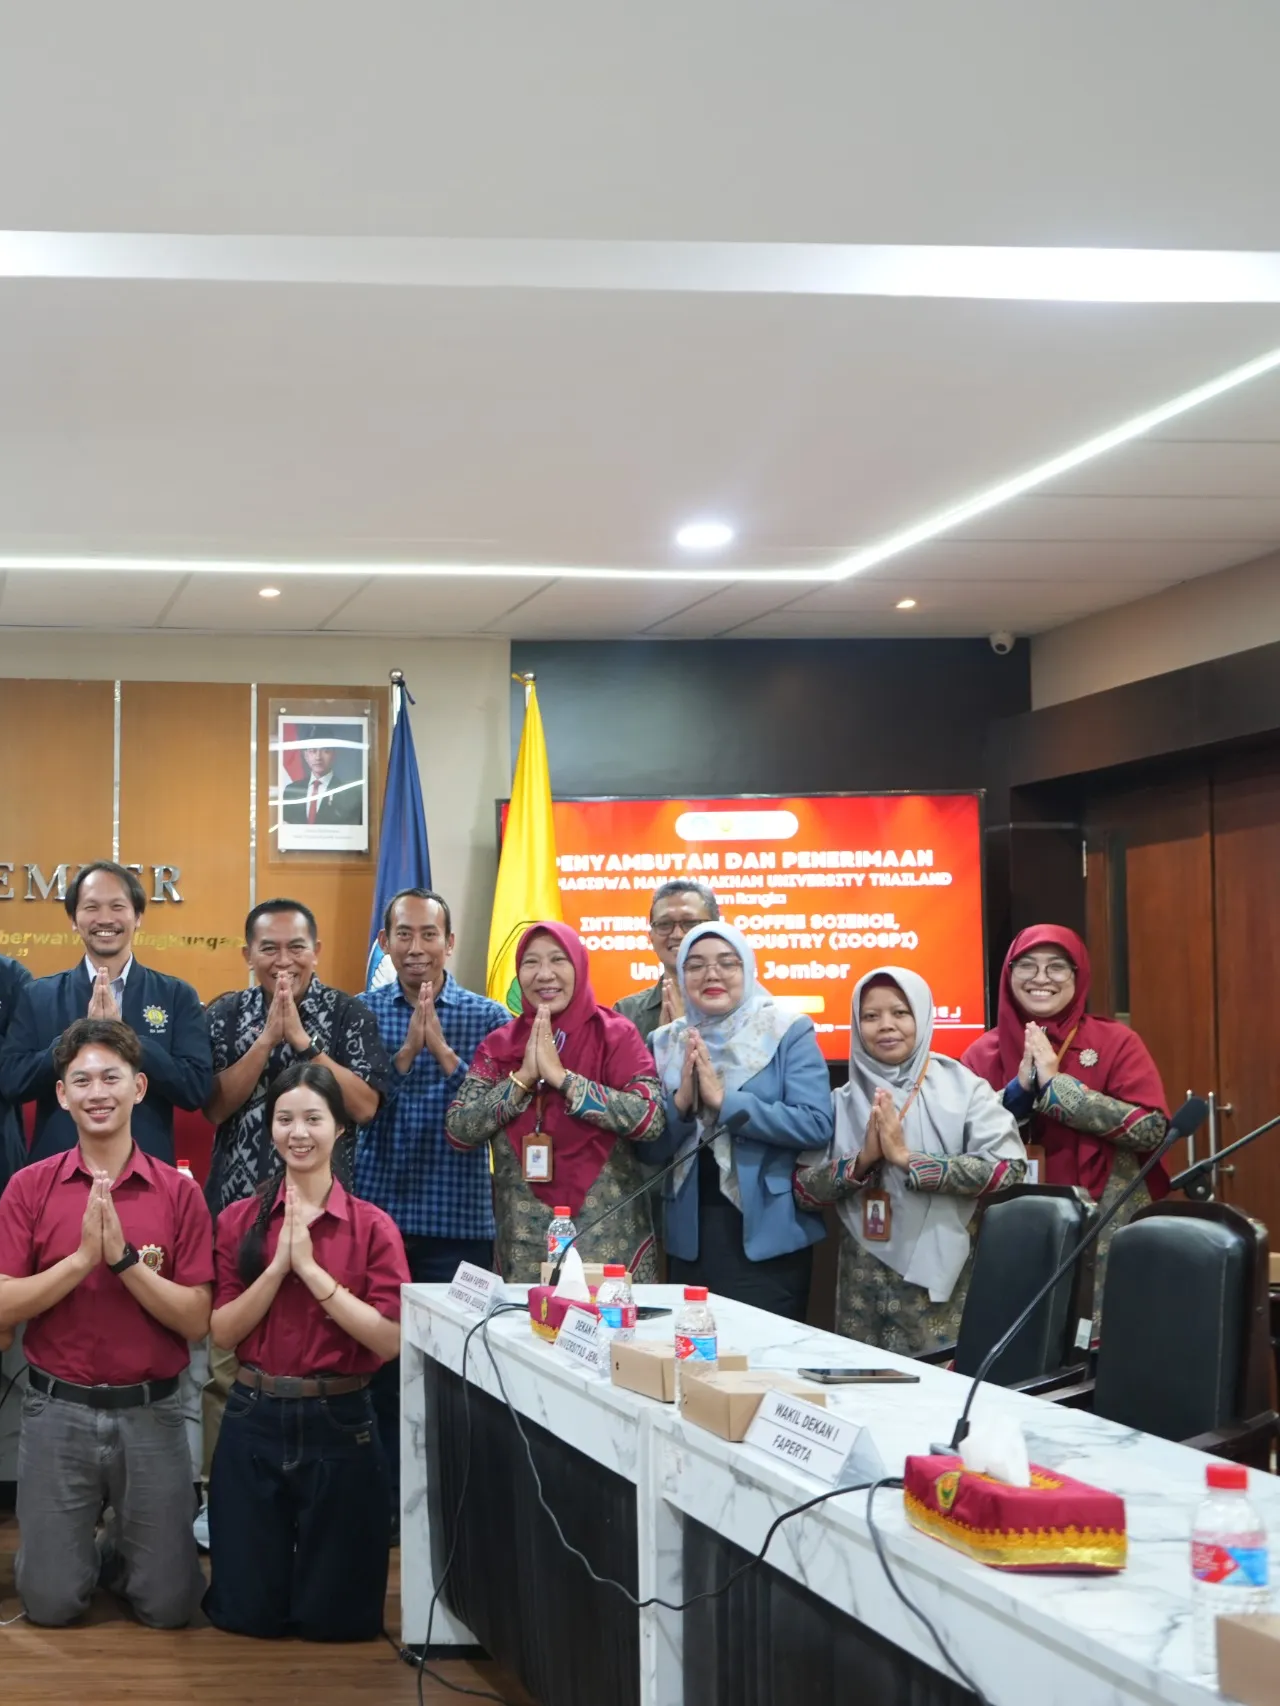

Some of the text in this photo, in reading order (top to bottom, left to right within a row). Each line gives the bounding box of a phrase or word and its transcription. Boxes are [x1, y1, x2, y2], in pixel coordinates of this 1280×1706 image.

[725, 851, 776, 869] DAN
[782, 850, 934, 869] PENERIMAAN
[767, 873, 866, 888] UNIVERSITY
[869, 872, 953, 886] THAILAND
[734, 914, 806, 930] COFFEE
[763, 960, 851, 980] Jember
[575, 1319, 593, 1337] DEKAN
[773, 1402, 801, 1425] WAKIL
[801, 1414, 834, 1440] DEKAN
[771, 1433, 813, 1463] FAPERTA
